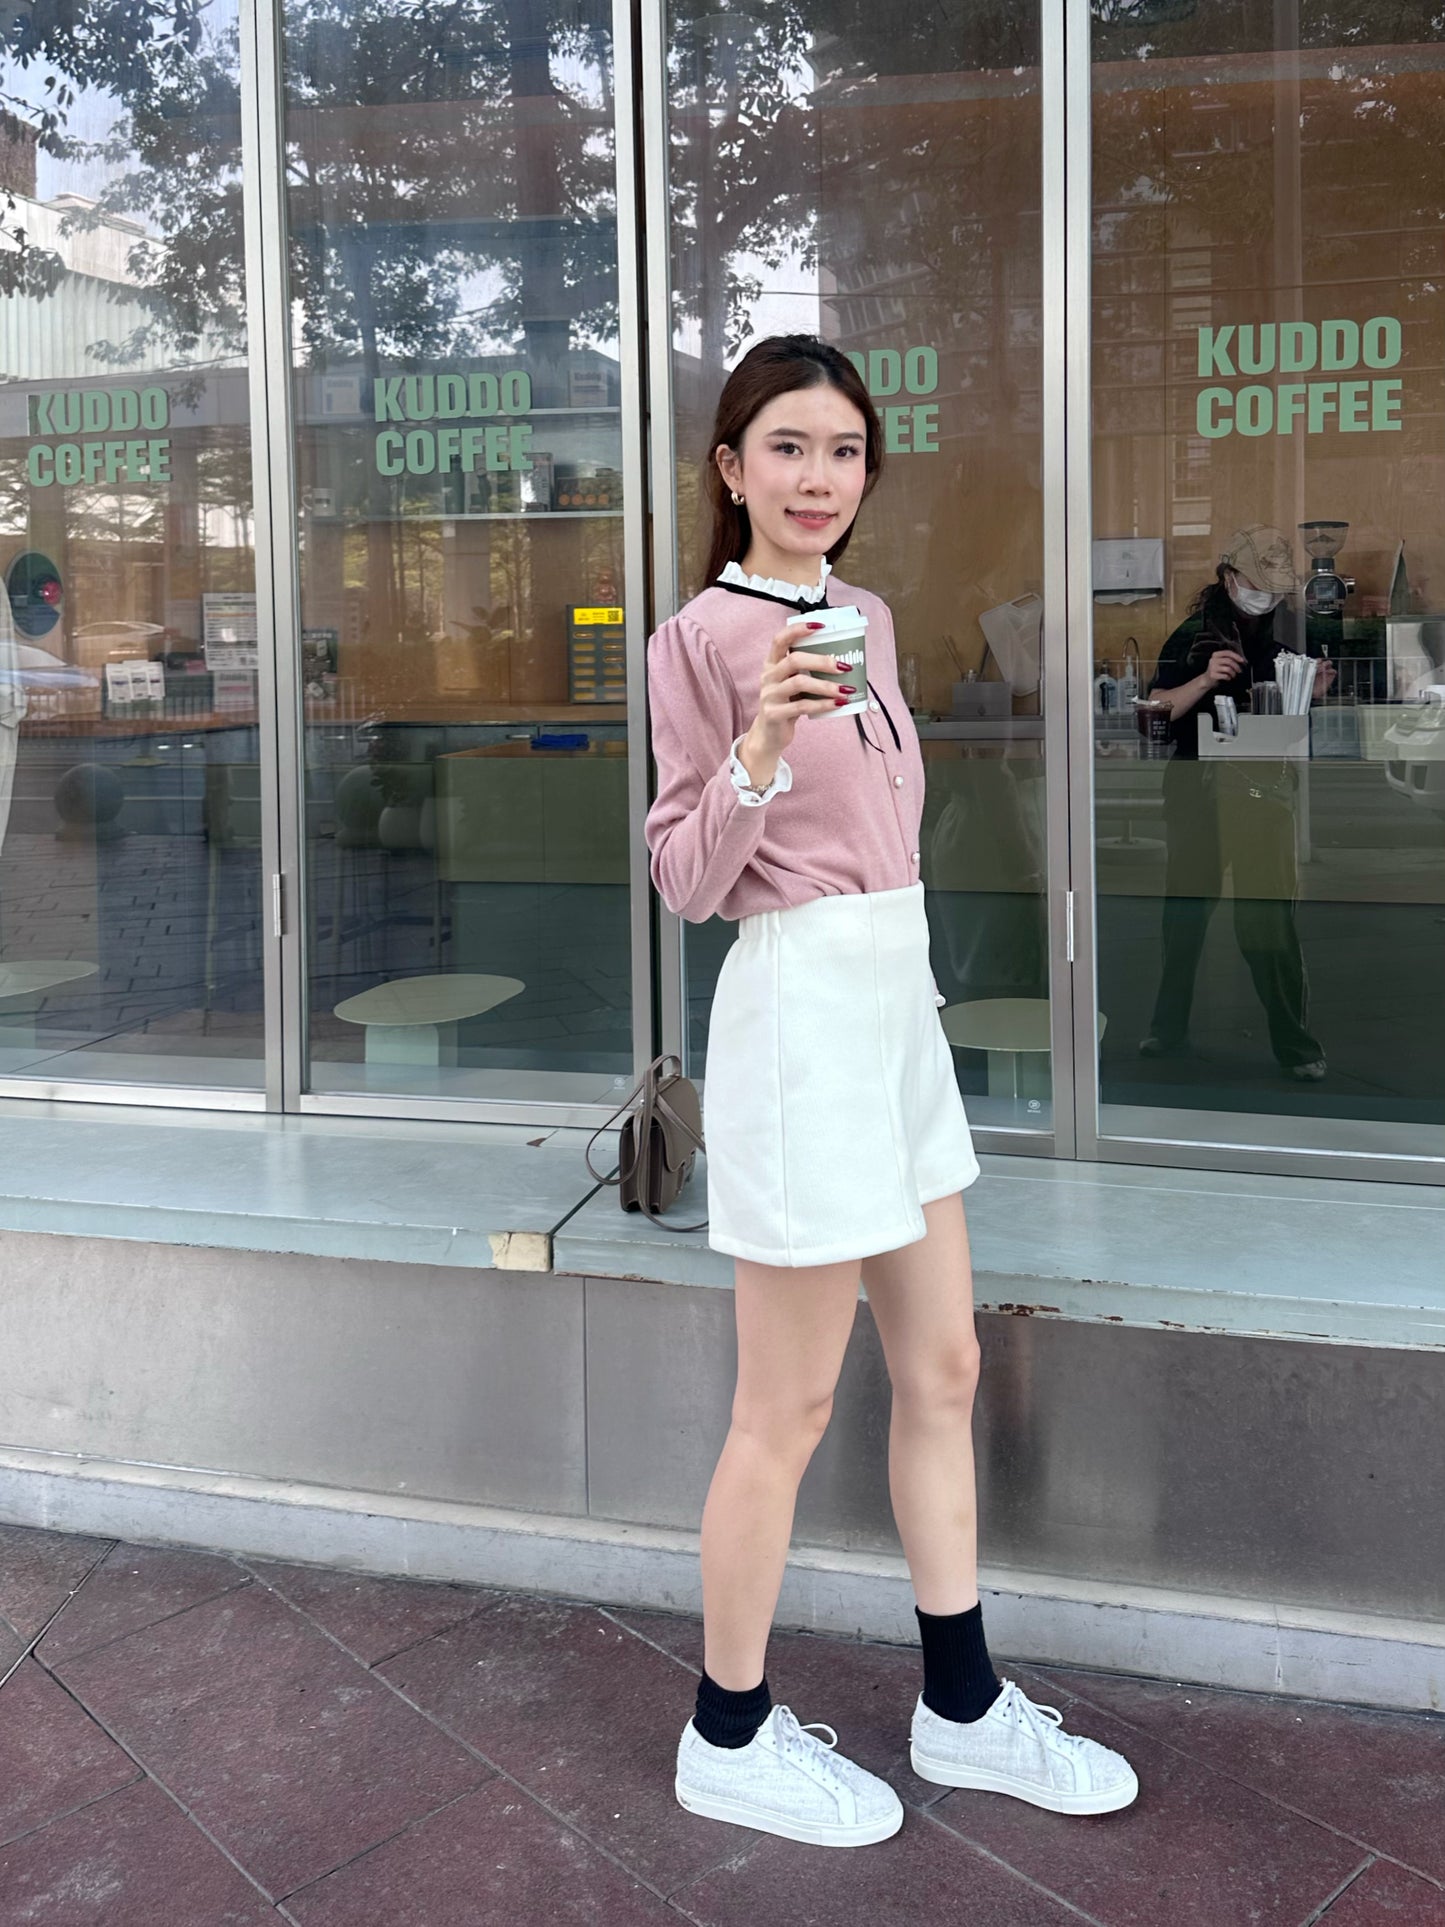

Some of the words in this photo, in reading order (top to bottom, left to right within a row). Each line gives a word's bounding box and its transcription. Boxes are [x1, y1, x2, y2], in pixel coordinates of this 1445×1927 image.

[1197, 316, 1402, 377] KUDDO
[28, 387, 169, 436] KUDDO
[373, 370, 532, 422] KUDDO
[1196, 379, 1402, 438] COFFEE
[27, 438, 171, 488] COFFEE
[375, 425, 534, 476] COFFEE
